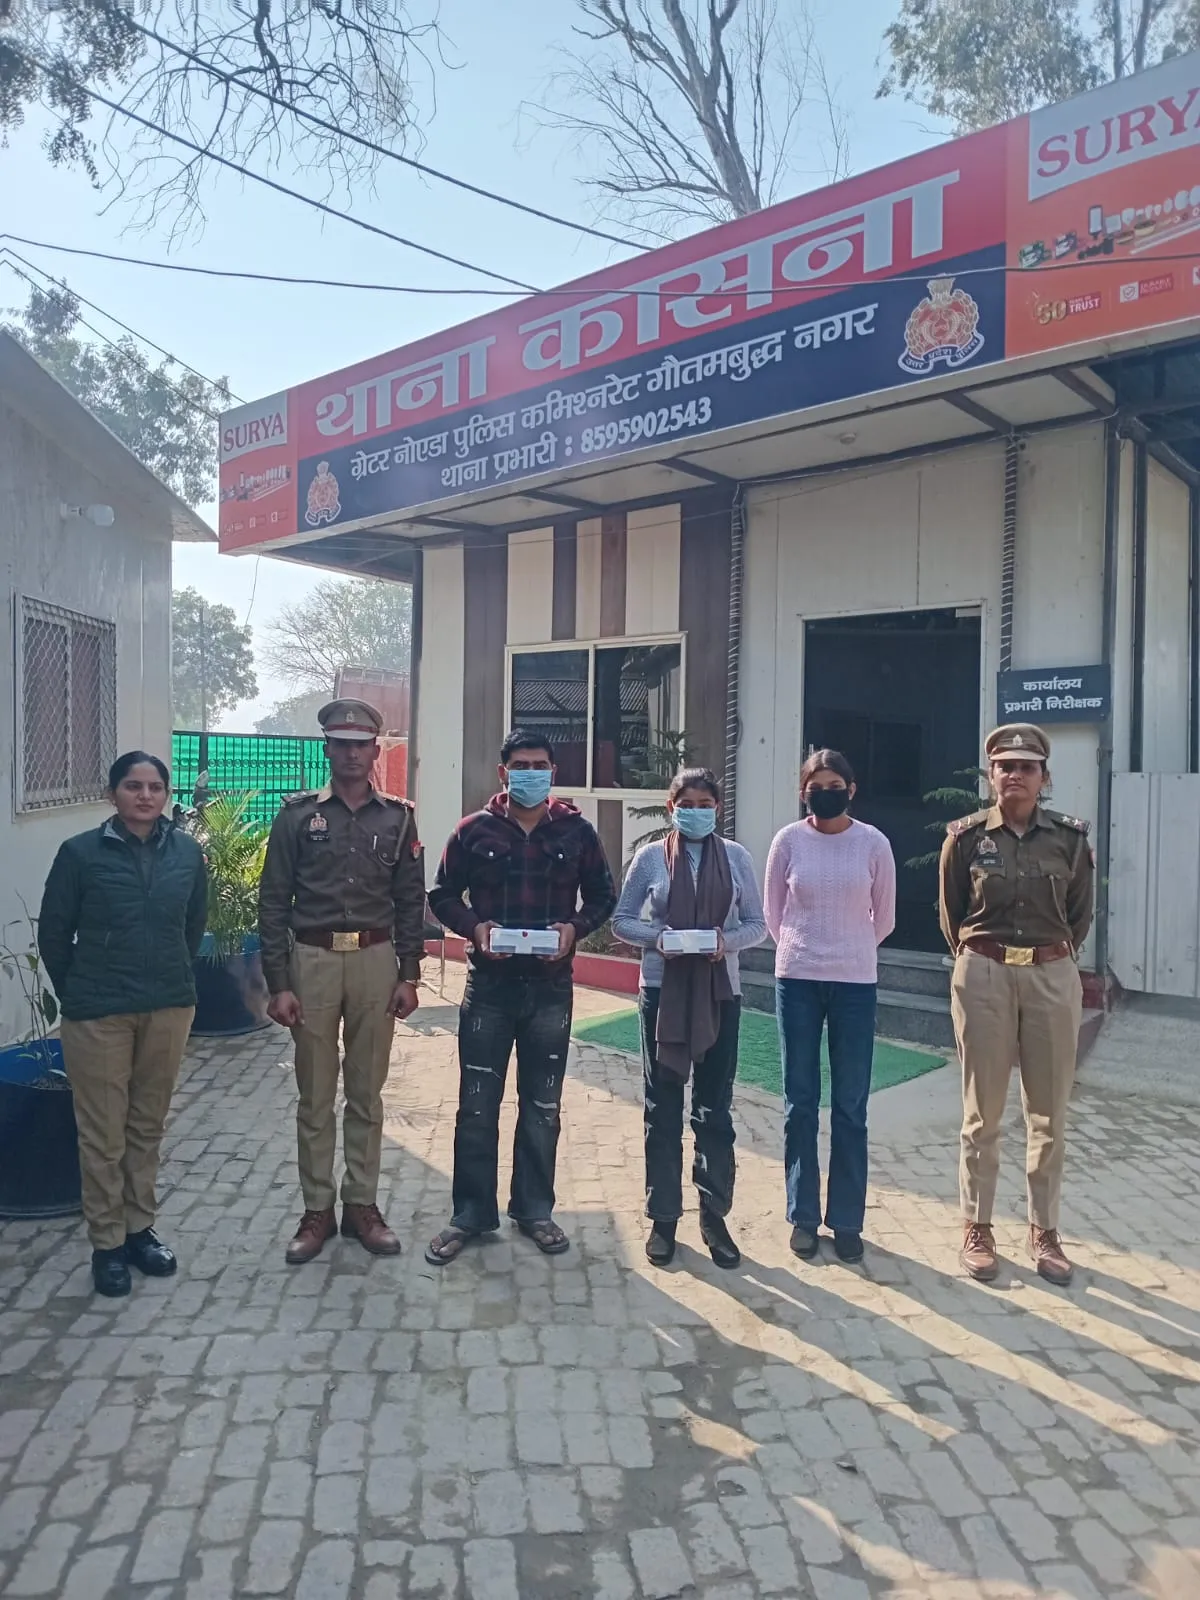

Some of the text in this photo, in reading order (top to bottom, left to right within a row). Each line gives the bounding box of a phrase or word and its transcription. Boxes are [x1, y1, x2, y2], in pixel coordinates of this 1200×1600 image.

[1037, 87, 1200, 178] SURY
[315, 169, 960, 436] थाना कासना
[1069, 298, 1100, 314] TRUST
[350, 302, 879, 481] ग्रेटर नोएडा पुलिस कमिश्नरेट गौतमबुद्ध नगर
[223, 412, 284, 452] SURYA
[441, 460, 487, 489] थाना
[494, 432, 558, 480] प्रभारी
[580, 396, 712, 454] 8595902543
[1004, 695, 1103, 714] प्रभारी निरीक्षक
[1023, 676, 1083, 691] कार्यालय
